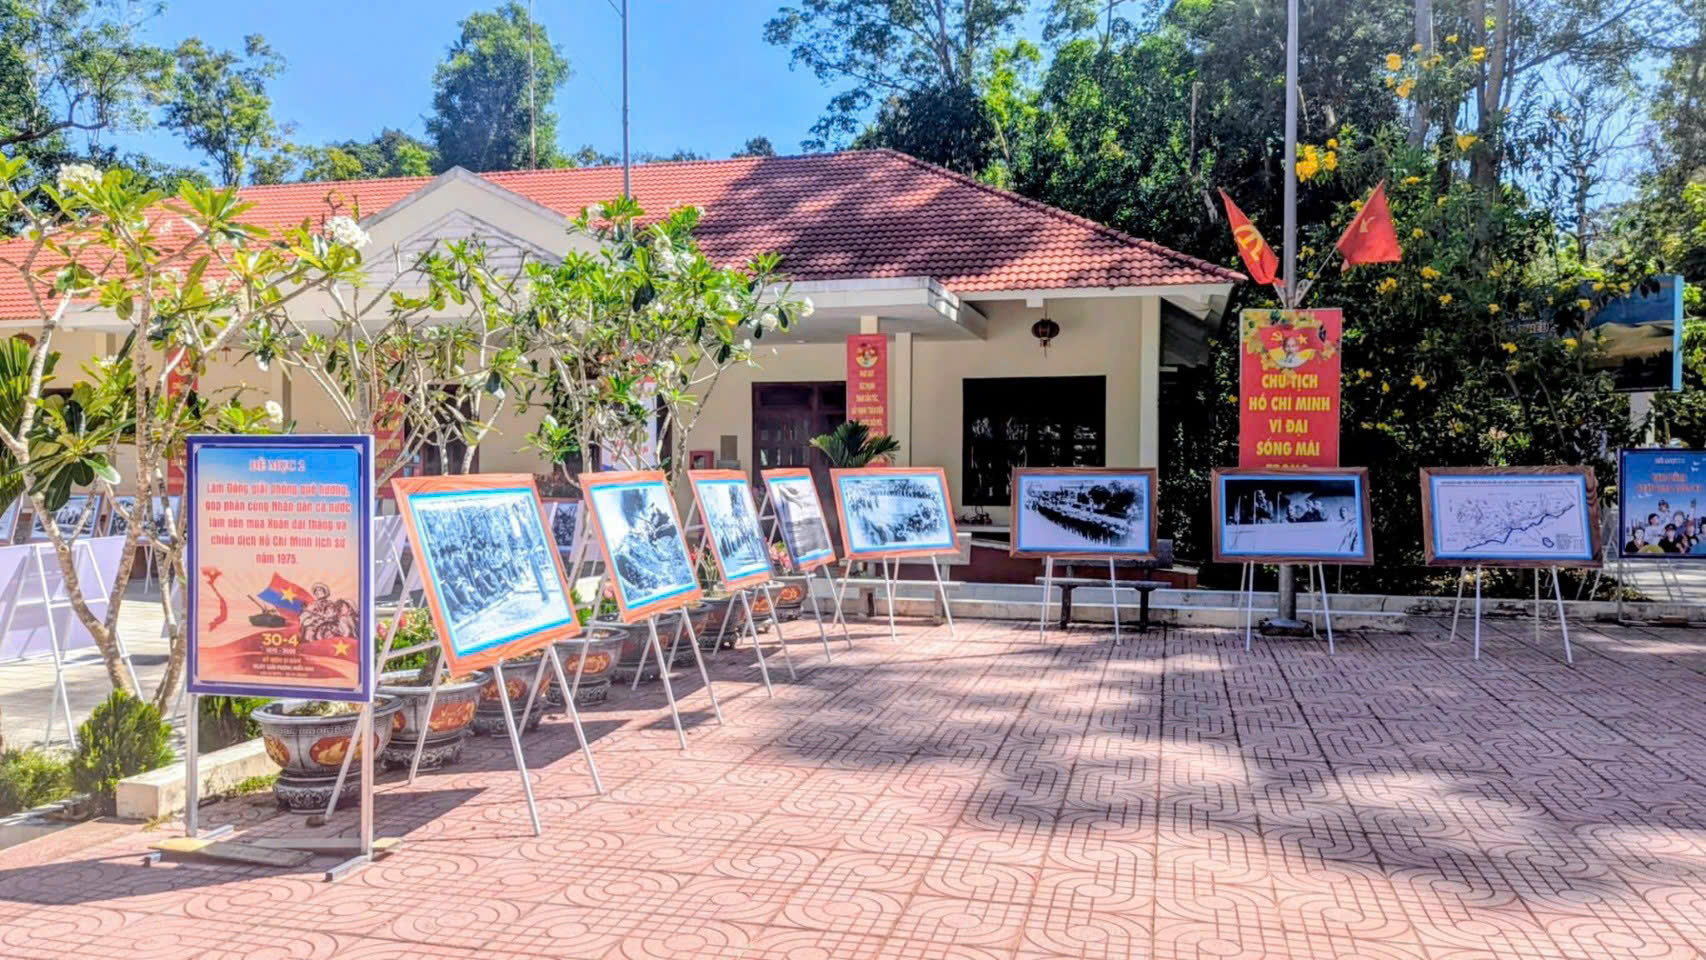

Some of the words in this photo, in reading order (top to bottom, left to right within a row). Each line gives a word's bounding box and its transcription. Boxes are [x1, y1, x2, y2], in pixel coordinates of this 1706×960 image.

[1290, 373, 1318, 392] TỊCH
[1295, 396, 1331, 411] MINH
[1286, 418, 1309, 437] ĐẠI
[1256, 436, 1292, 456] SỐNG
[289, 534, 313, 548] Minh
[262, 633, 298, 647] 30-4
